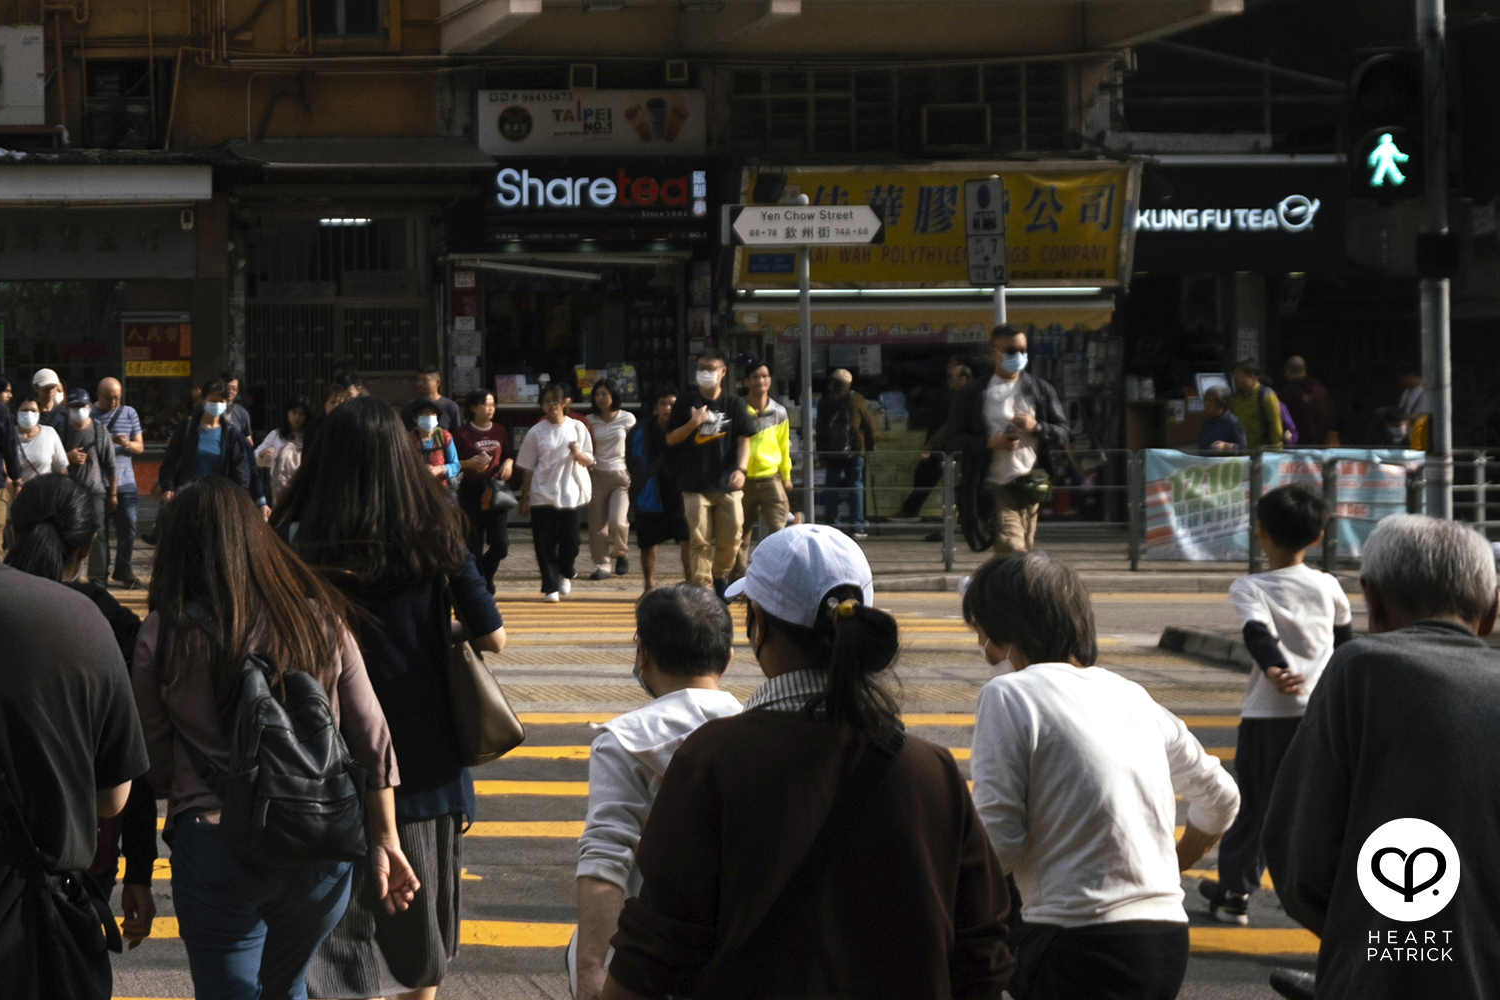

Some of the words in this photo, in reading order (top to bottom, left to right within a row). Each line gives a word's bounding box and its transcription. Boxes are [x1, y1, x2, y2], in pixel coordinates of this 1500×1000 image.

[552, 99, 613, 122] TAIPEI
[583, 122, 613, 131] NO.1
[496, 167, 688, 207] Sharetea
[760, 210, 780, 221] Yen
[784, 210, 815, 221] Chow
[819, 209, 854, 221] Street
[813, 183, 1116, 235] 華膠公司
[1137, 208, 1199, 232] KUNG
[1200, 208, 1232, 232] FU
[1233, 208, 1278, 232] TEA
[784, 226, 830, 239] 欽州街
[838, 245, 871, 263] WAH
[881, 245, 967, 264] POLYTHYLE
[1040, 243, 1109, 263] COMPANY
[992, 265, 1005, 281] 12
